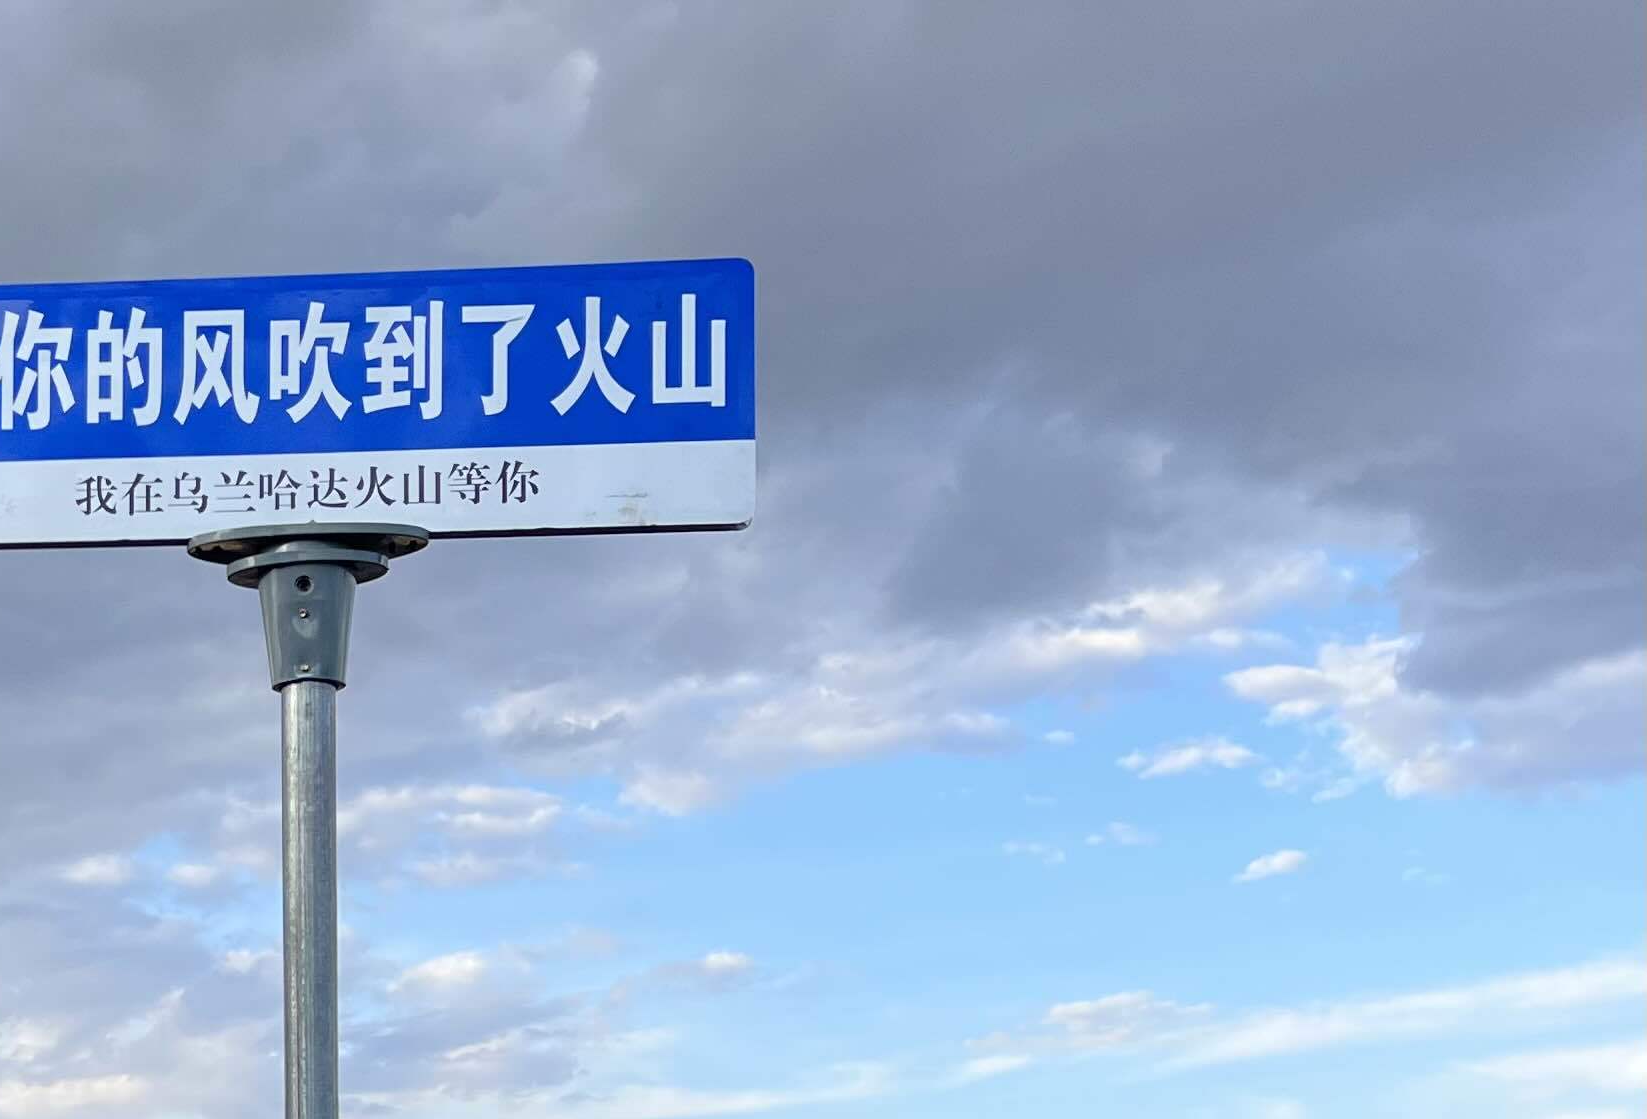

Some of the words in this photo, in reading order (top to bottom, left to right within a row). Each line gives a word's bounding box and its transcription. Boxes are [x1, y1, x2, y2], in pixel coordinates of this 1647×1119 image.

[75, 461, 540, 517] 我在乌兰哈达火山等你
